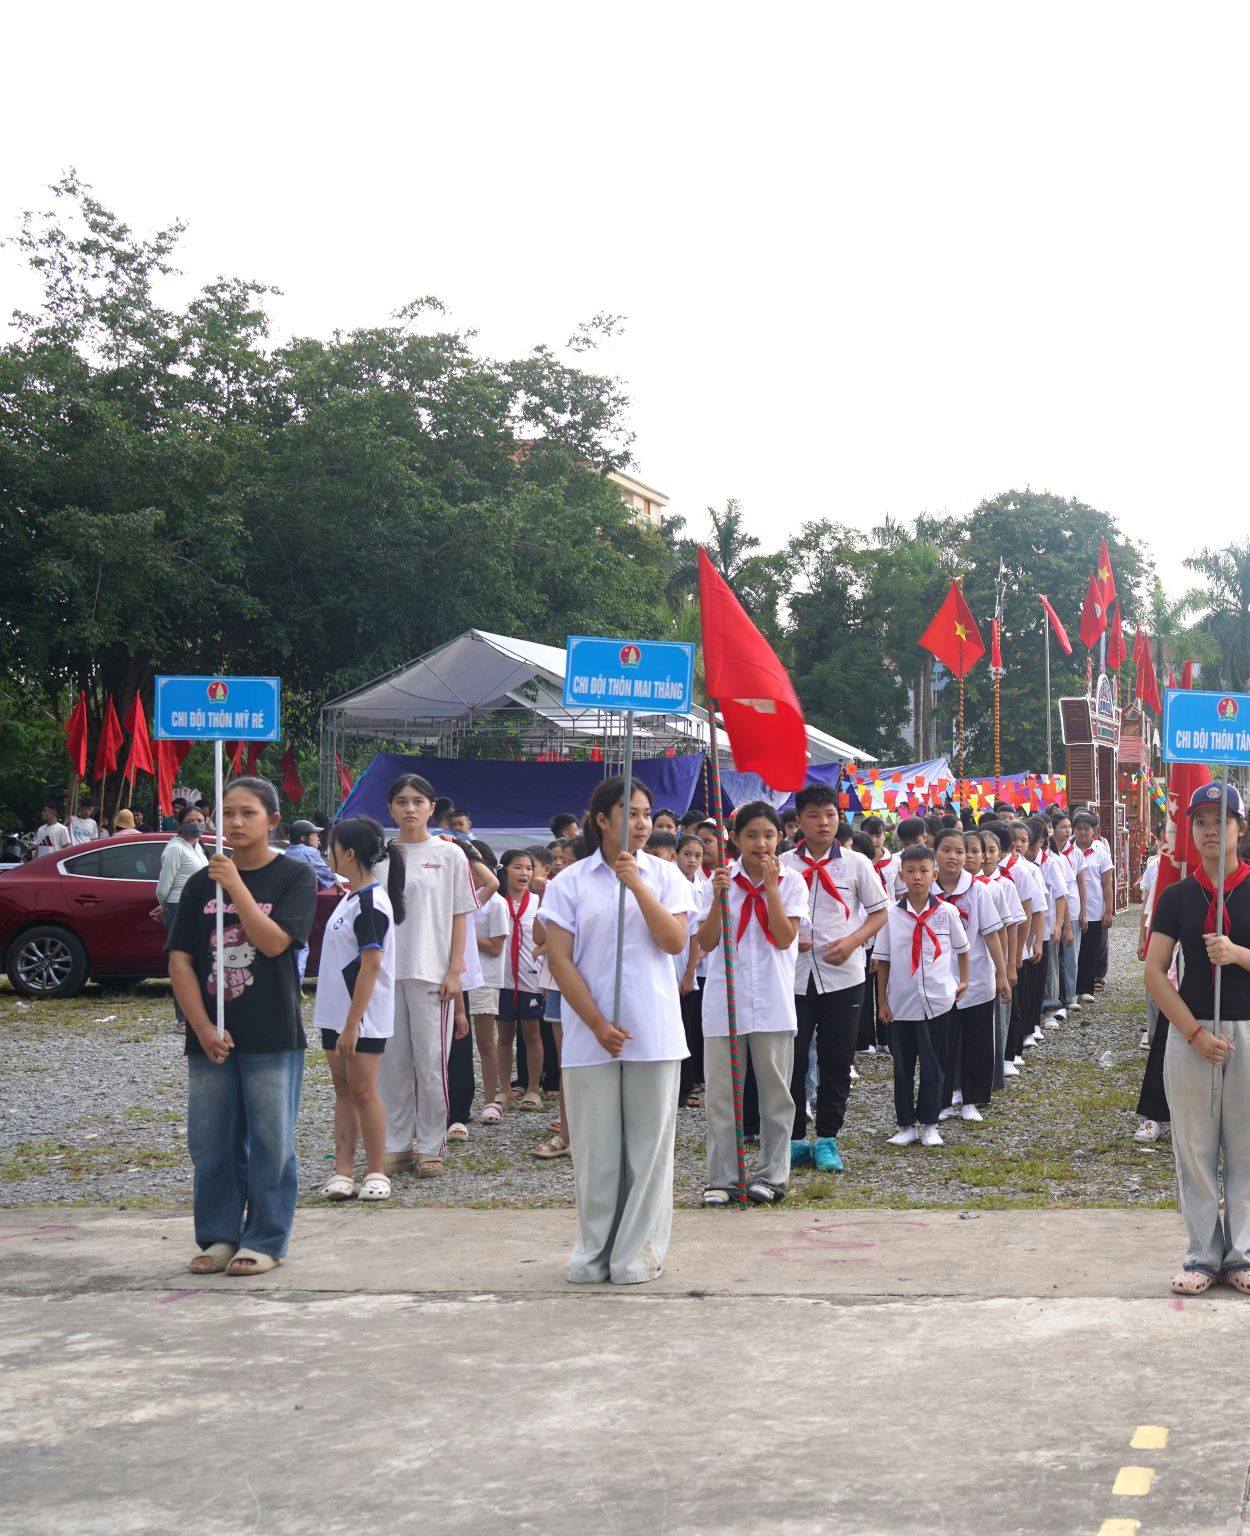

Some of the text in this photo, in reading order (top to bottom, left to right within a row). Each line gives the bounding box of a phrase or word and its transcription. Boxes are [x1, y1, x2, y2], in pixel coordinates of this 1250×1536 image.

[573, 673, 684, 700] CHI ĐỘI THÔN MAI THẮNG
[171, 708, 264, 731] CHI ĐỘI THÔN MỸ RÉ
[1176, 729, 1191, 749] CHI
[1193, 727, 1208, 753] ĐỘI
[1211, 728, 1234, 750] THÔN
